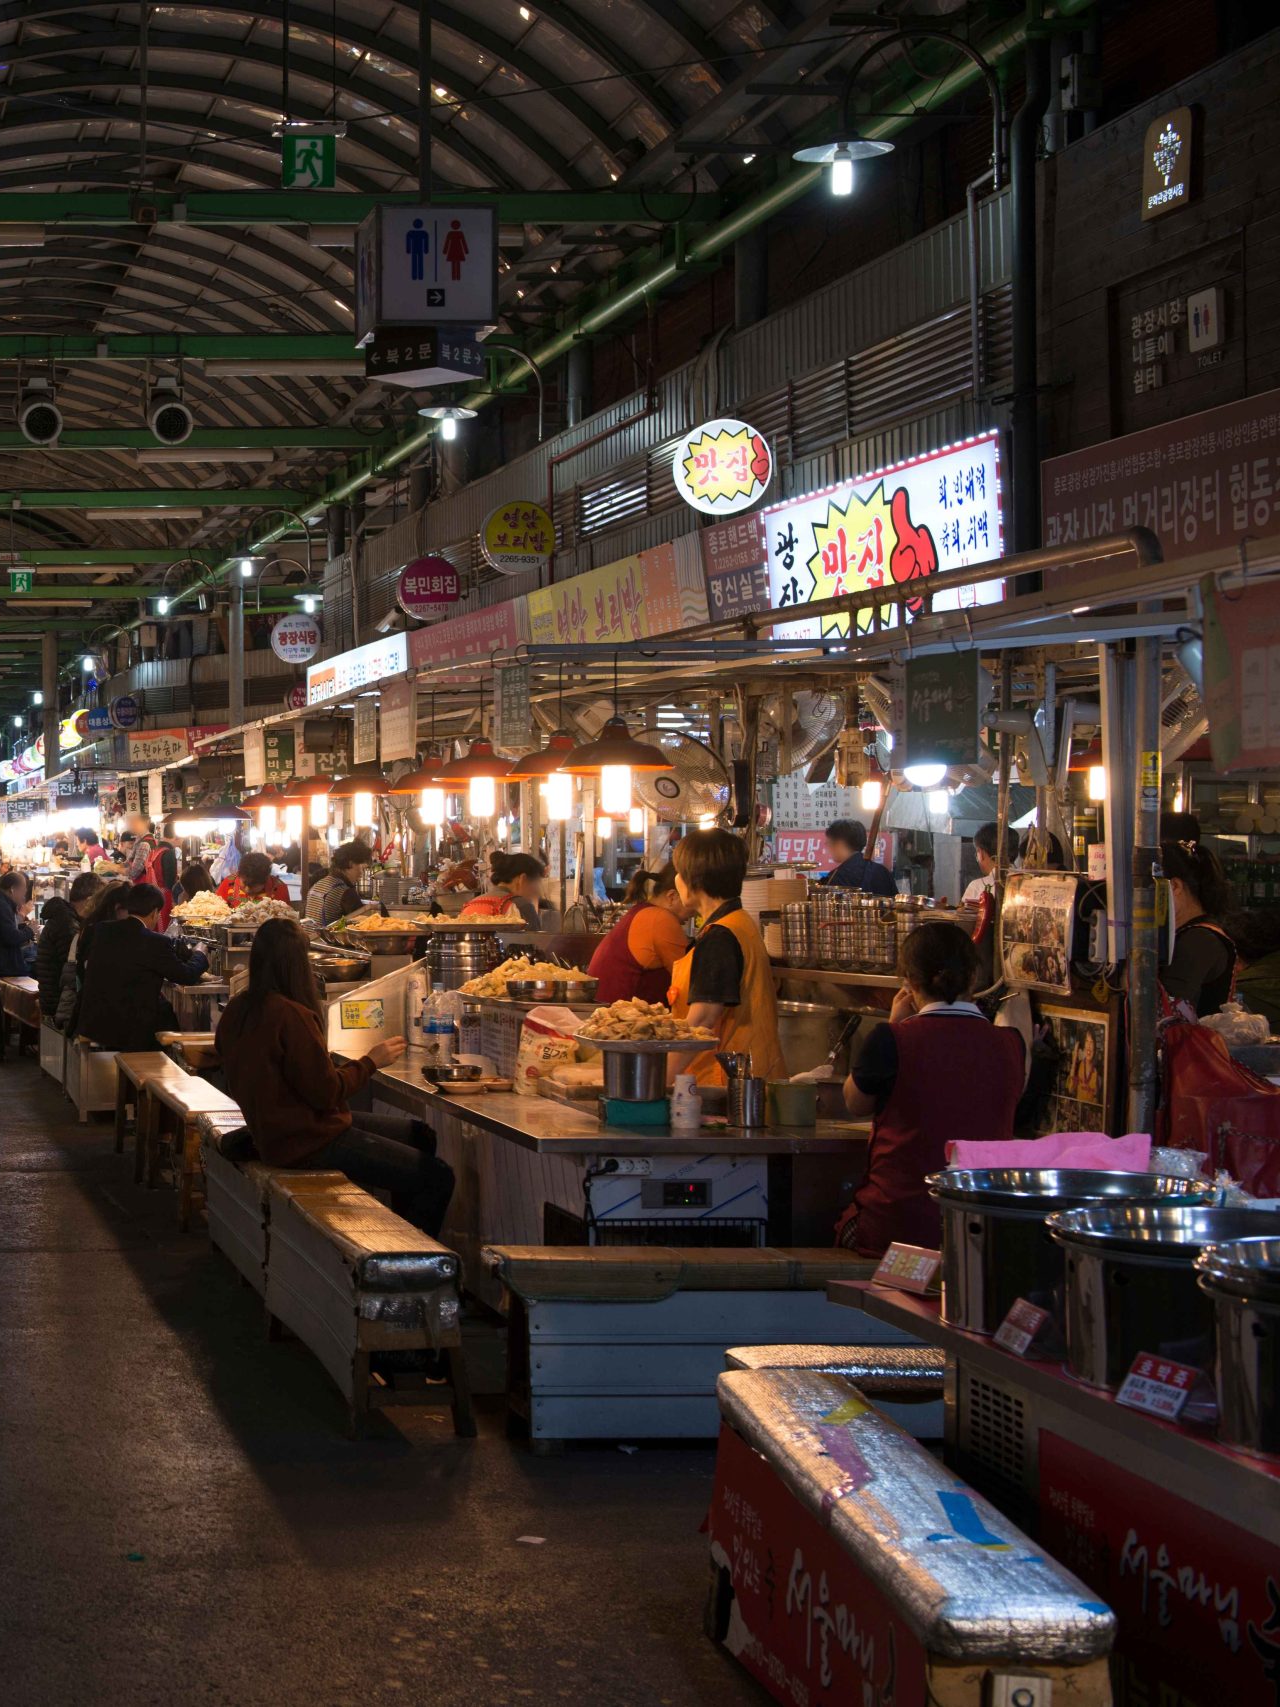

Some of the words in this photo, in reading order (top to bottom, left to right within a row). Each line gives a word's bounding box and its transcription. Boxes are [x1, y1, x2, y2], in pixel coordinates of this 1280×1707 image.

[1130, 298, 1183, 339] 광장시장
[1131, 332, 1169, 366] 나들이
[1197, 350, 1222, 369] TOILET
[1133, 365, 1158, 395] 쉼터
[693, 445, 749, 487] 맛집
[1228, 456, 1280, 533] 협동
[707, 519, 759, 557] 종로핸드백
[821, 516, 884, 598] 맛집
[404, 572, 458, 596] 복민회집
[710, 568, 768, 607] 명신실크
[278, 630, 318, 646] 광장식당
[1136, 1358, 1190, 1389] 호박죽
